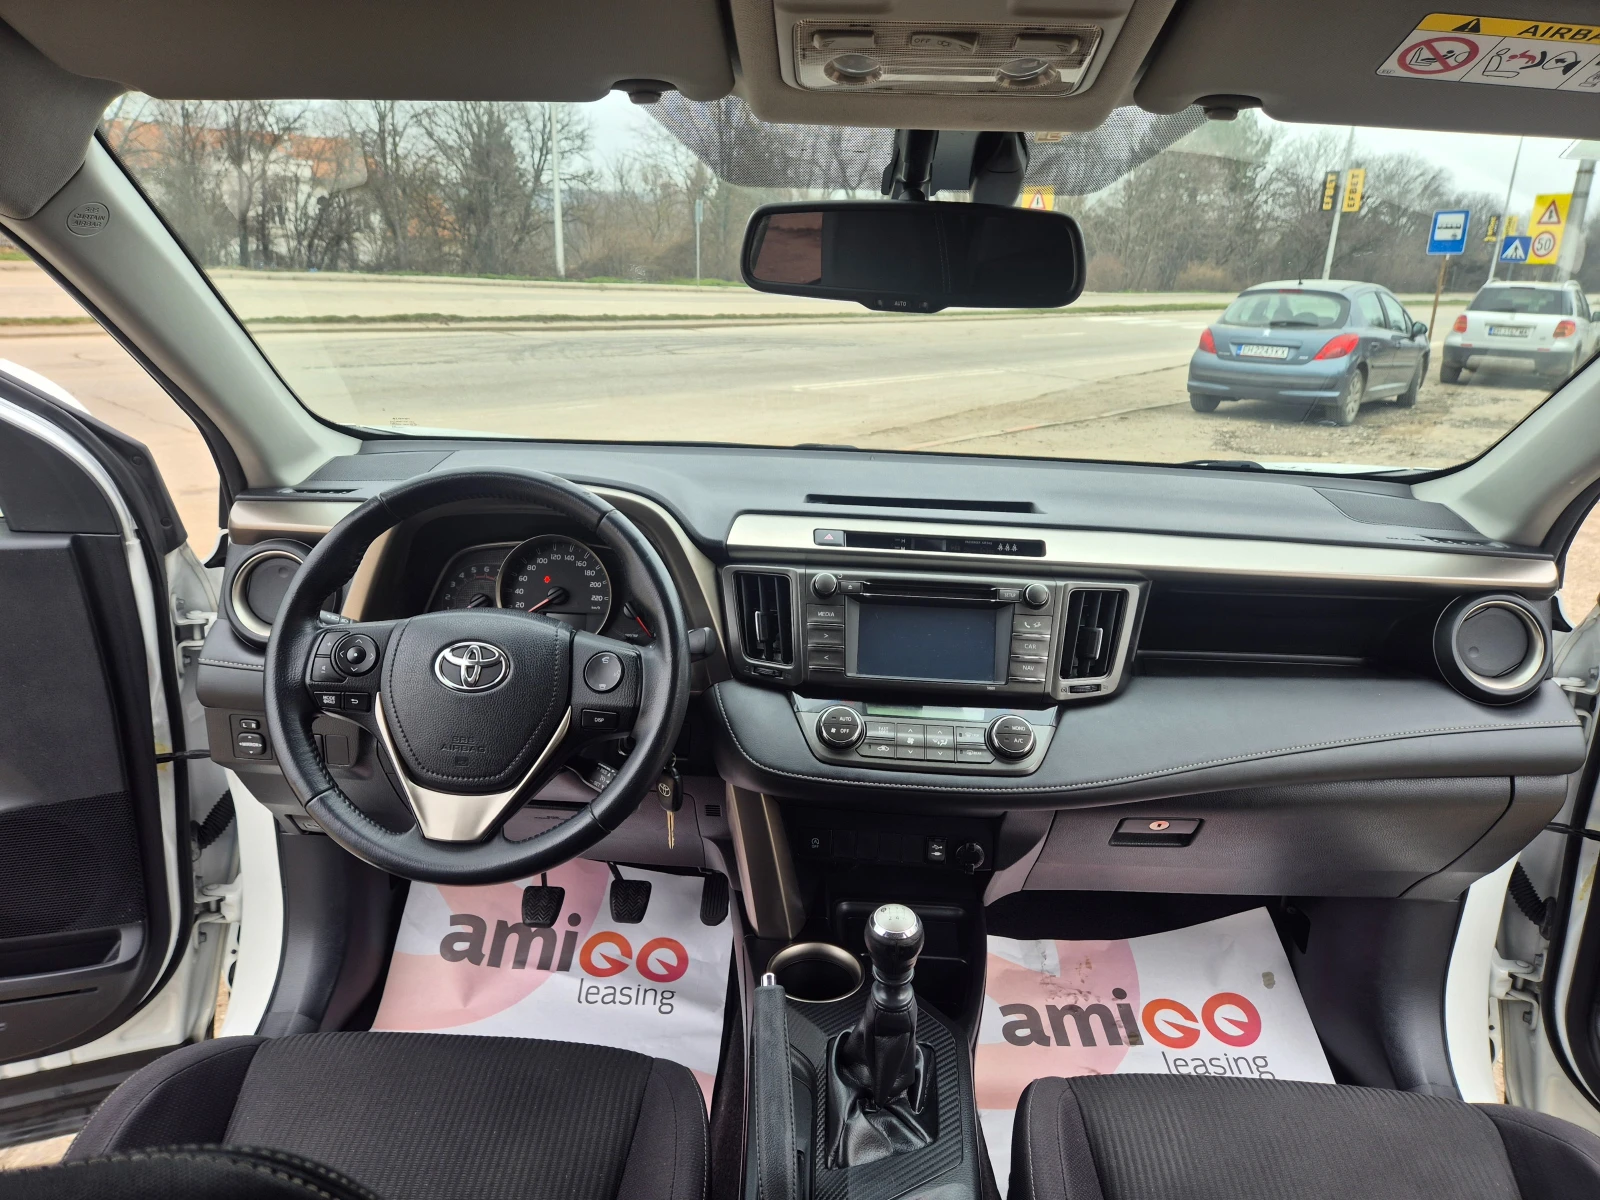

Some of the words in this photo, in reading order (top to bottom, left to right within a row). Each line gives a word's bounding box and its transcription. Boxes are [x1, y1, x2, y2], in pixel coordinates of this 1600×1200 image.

[74, 213, 105, 221] CURTAIN
[1536, 237, 1551, 251] 50
[577, 978, 676, 1015] leasing
[1161, 1051, 1276, 1080] leasing
